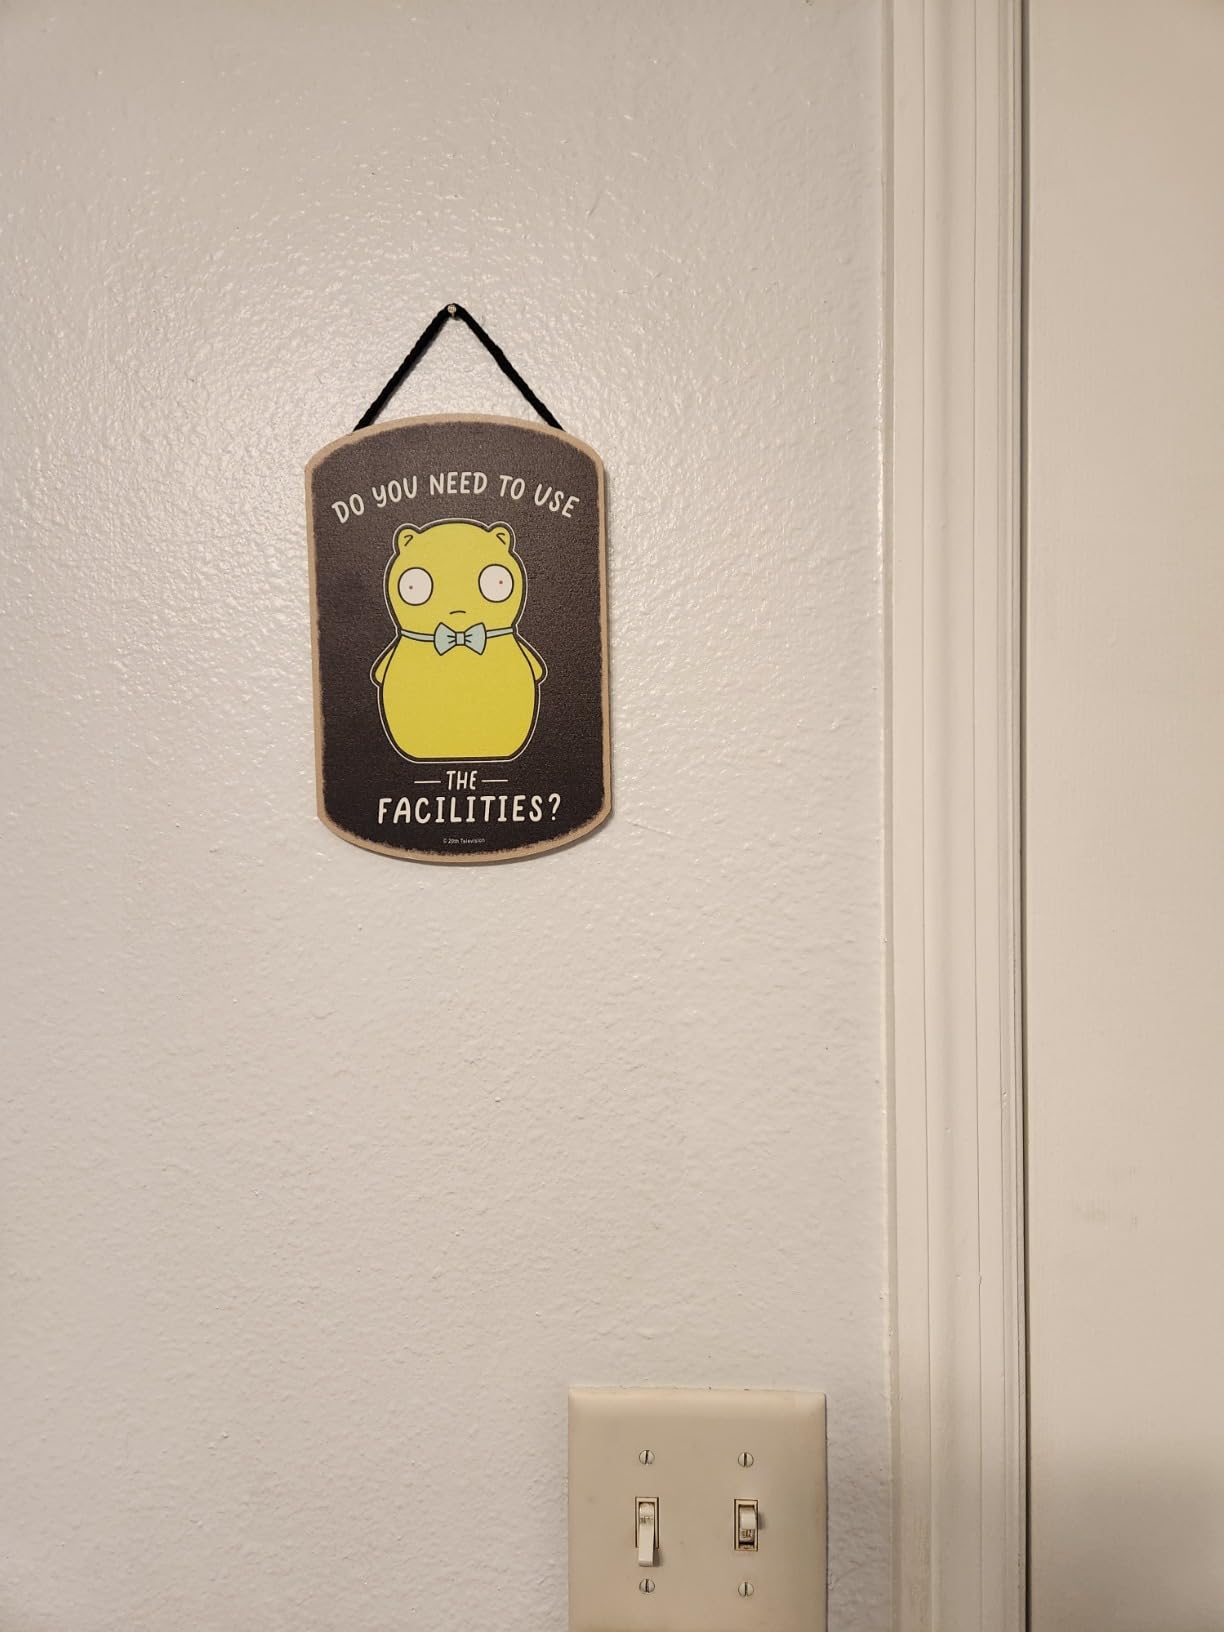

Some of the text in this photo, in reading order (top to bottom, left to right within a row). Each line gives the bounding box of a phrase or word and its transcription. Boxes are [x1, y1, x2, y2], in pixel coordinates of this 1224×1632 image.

[332, 472, 579, 523] DO YOU NEED TO USE
[446, 770, 478, 790] THE
[378, 793, 561, 823] FACILITIES?
